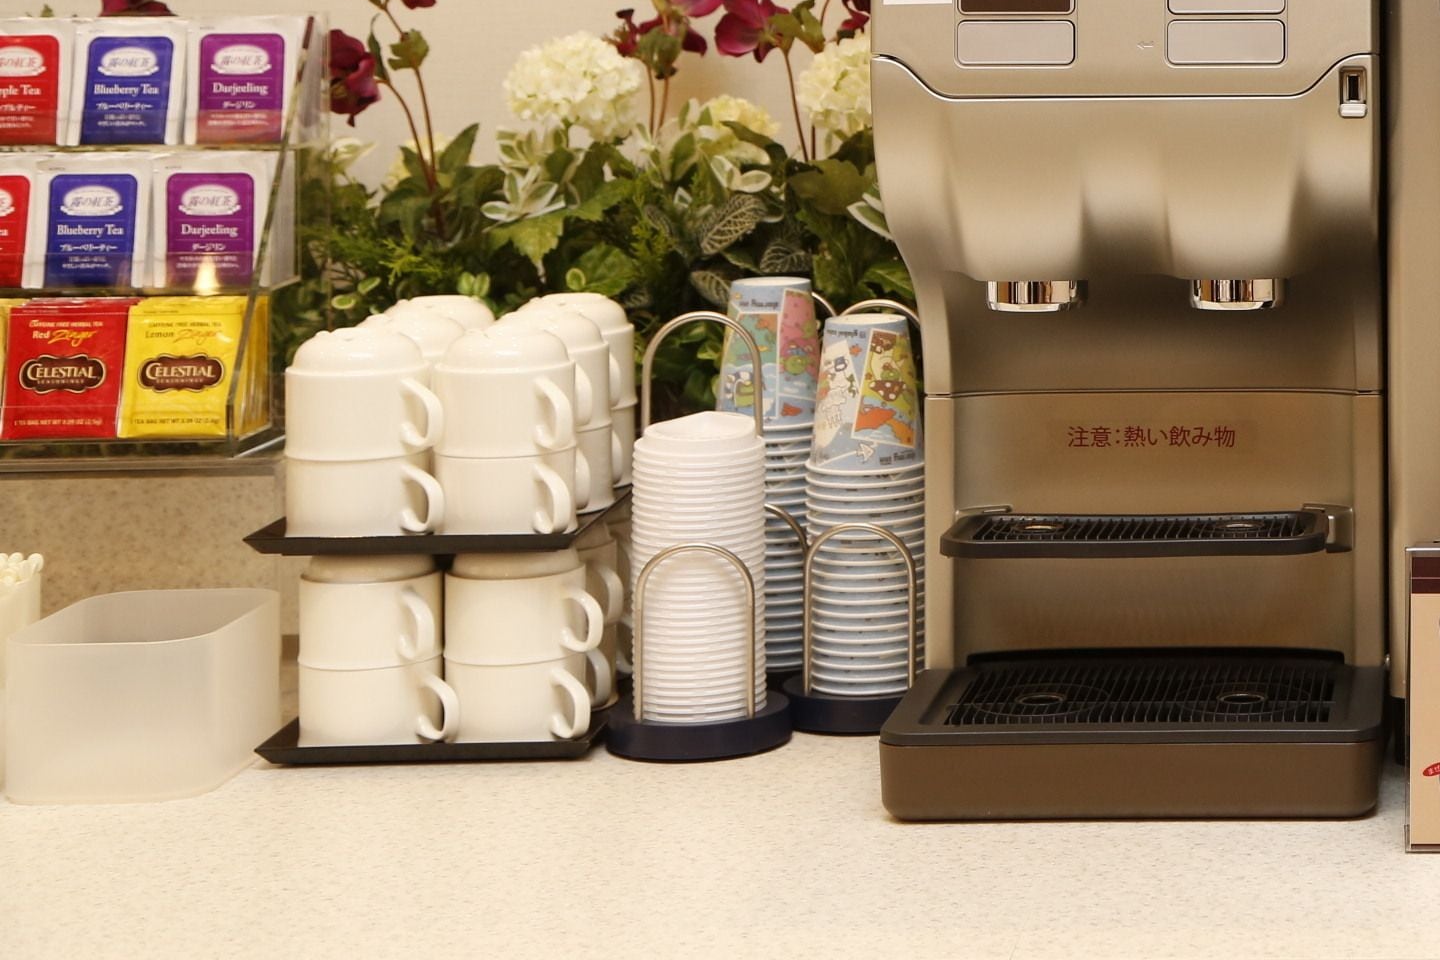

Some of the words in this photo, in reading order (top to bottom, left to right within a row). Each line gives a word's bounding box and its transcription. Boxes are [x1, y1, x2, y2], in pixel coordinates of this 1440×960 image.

[20, 84, 41, 95] Tea
[94, 84, 139, 97] Blueberry
[141, 84, 159, 95] Tea
[212, 82, 269, 96] Darjeeling
[56, 224, 104, 238] Blueberry
[105, 224, 124, 236] Tea
[181, 224, 238, 238] Darjeeling
[32, 330, 50, 339] Red
[145, 331, 175, 339] Lemon
[27, 363, 98, 381] CELESTIAL
[145, 362, 217, 380] CELESTIAL
